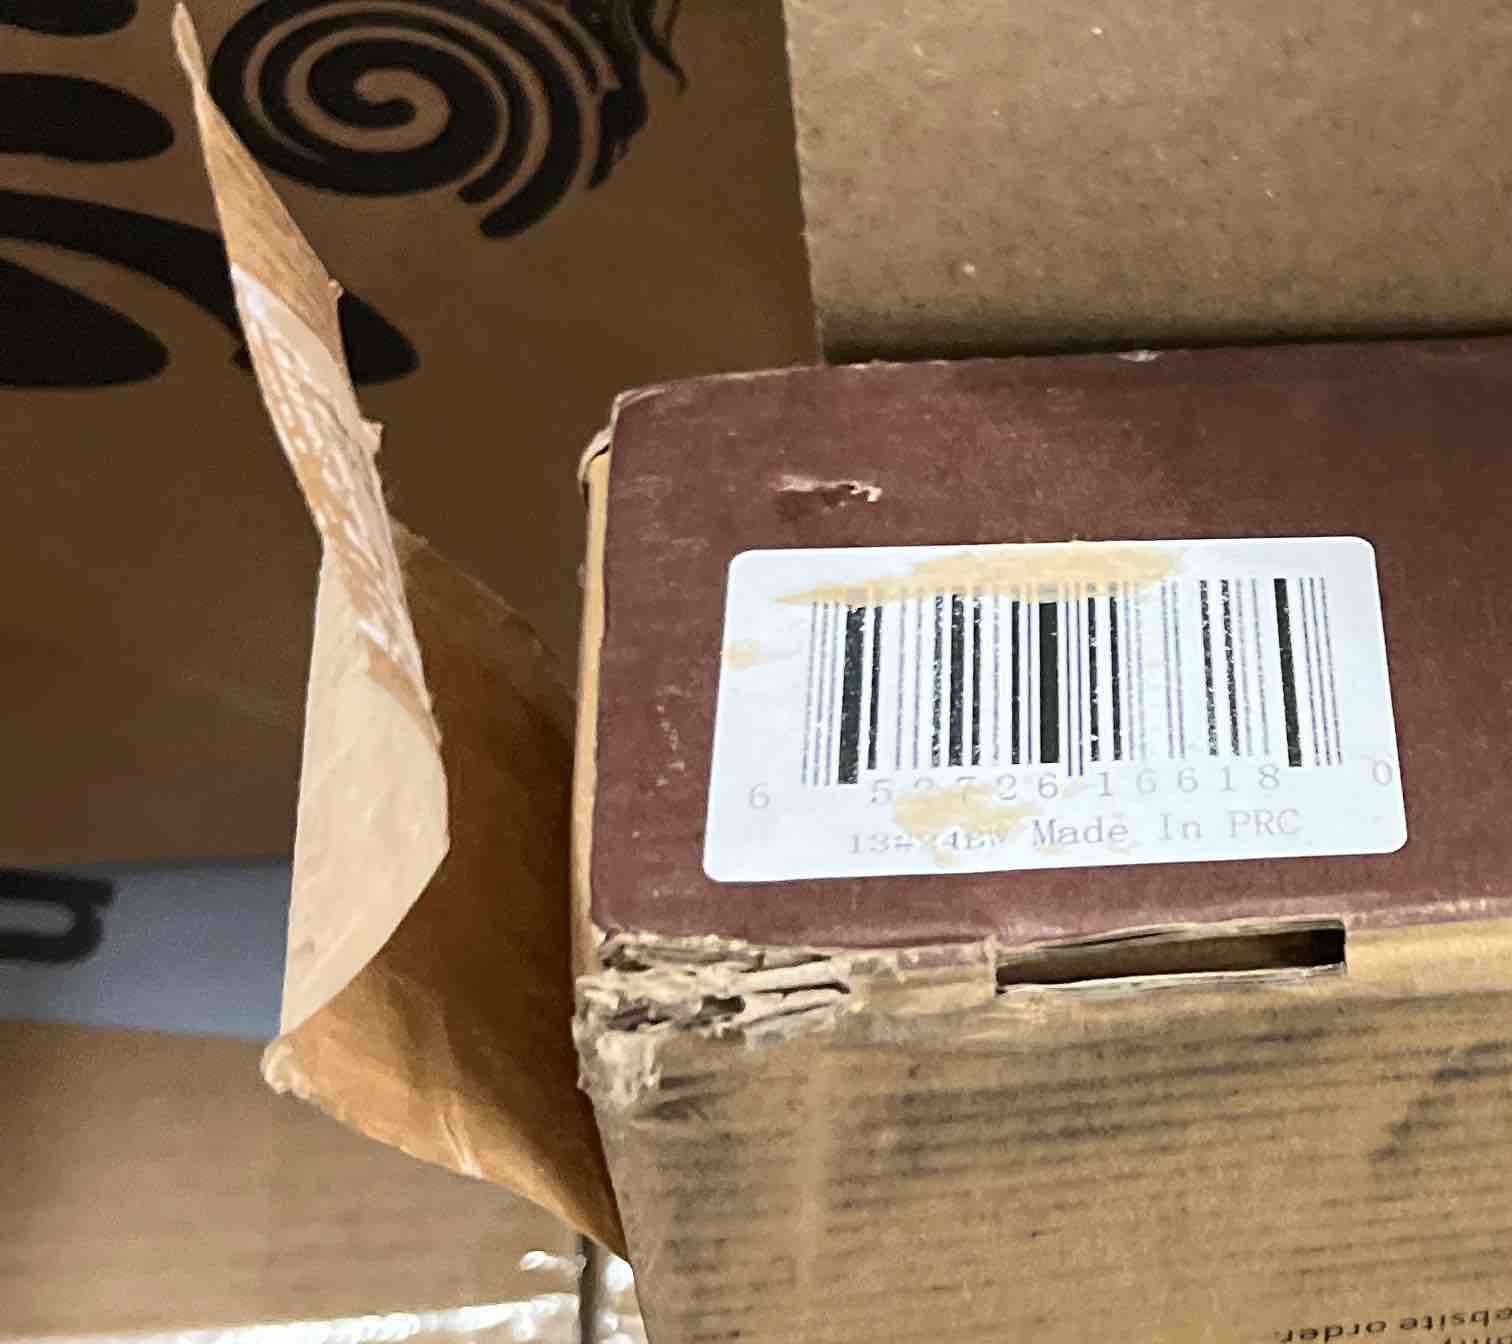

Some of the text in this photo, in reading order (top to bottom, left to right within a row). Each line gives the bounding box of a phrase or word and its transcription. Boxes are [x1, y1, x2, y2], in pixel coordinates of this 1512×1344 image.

[1032, 817, 1129, 846] Made
[1159, 812, 1203, 841] In
[1226, 807, 1302, 839] PRC
